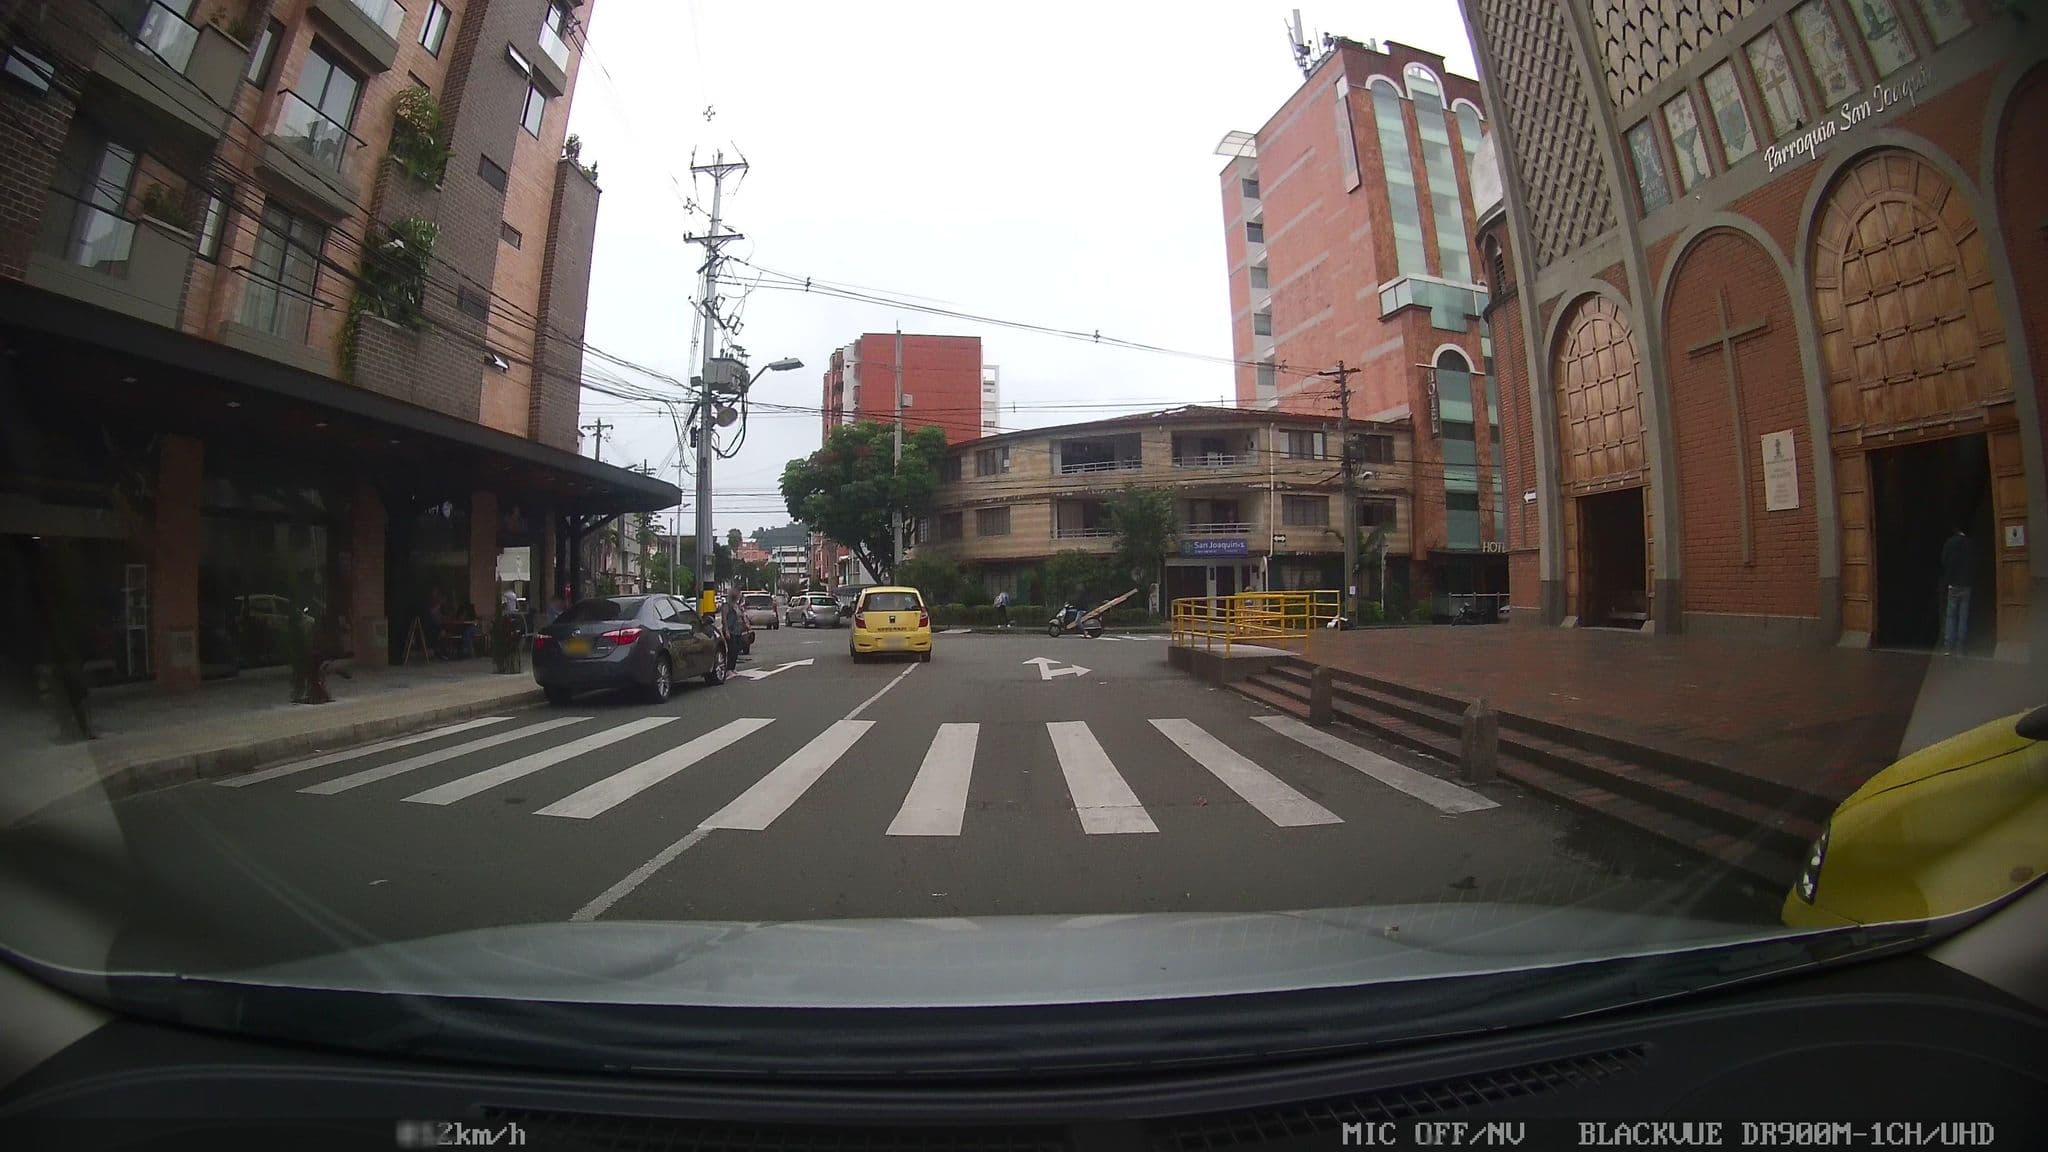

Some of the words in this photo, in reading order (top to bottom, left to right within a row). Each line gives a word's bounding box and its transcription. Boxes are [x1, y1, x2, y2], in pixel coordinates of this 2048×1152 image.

[1763, 121, 1836, 173] Parroquia
[1839, 102, 1872, 132] San
[1873, 63, 1934, 113] Joaqui
